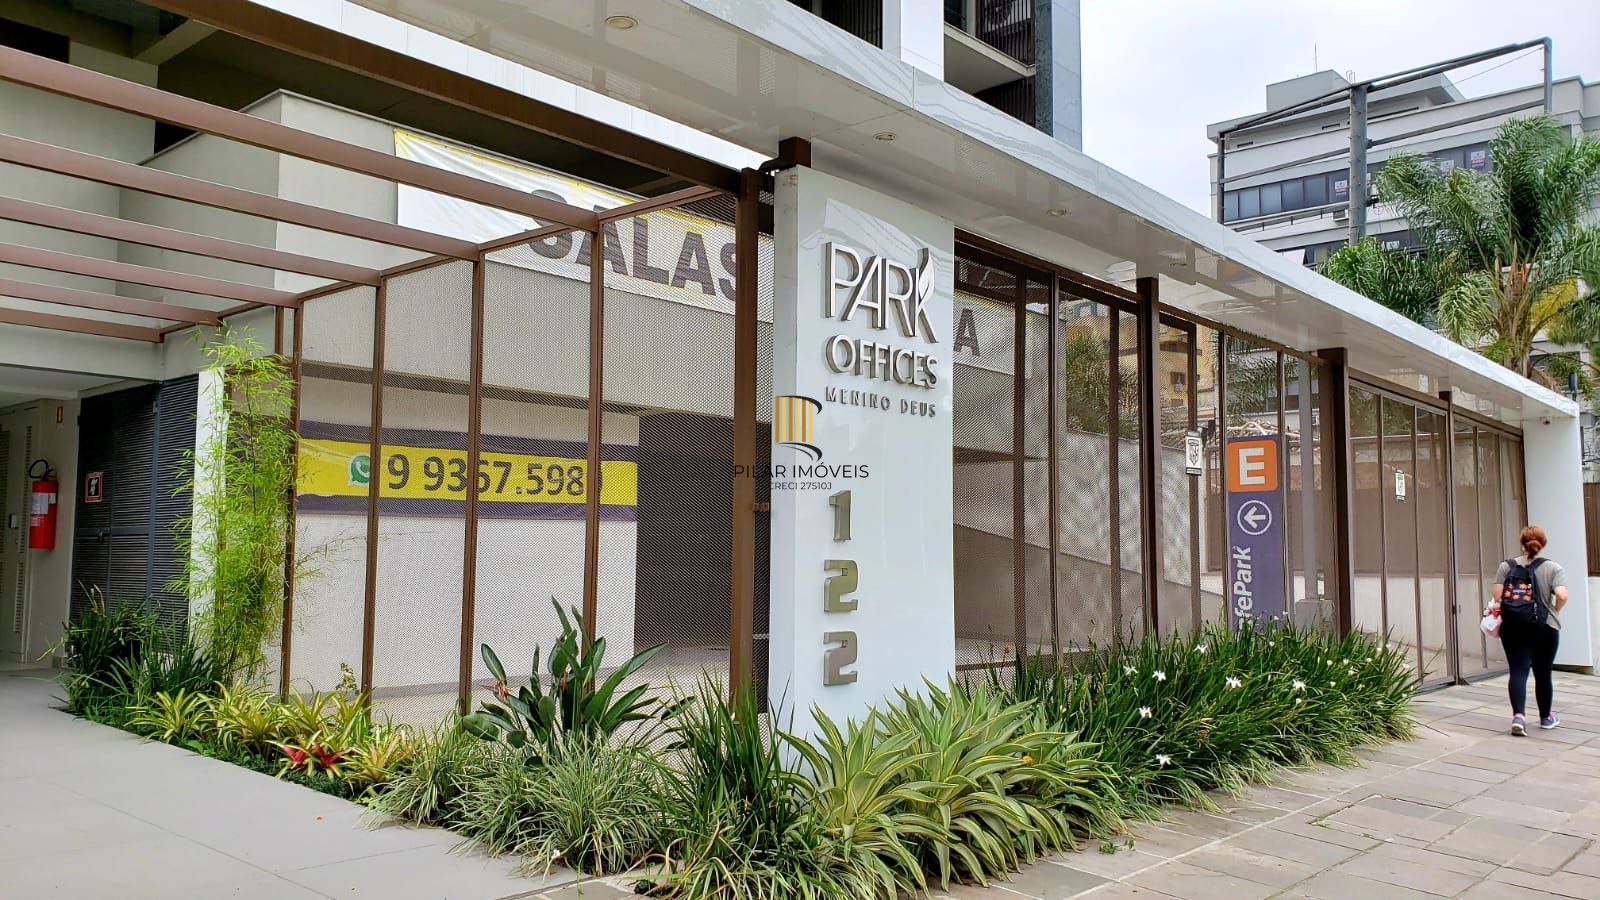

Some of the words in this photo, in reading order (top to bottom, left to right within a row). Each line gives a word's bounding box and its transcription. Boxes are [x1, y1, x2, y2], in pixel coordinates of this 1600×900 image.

[825, 241, 938, 343] PARK
[826, 334, 937, 389] OFFICES
[825, 386, 891, 411] MENINO
[900, 398, 936, 417] DEUS
[387, 453, 410, 490] 9
[423, 456, 603, 497] 9367.598
[1239, 447, 1265, 486] E
